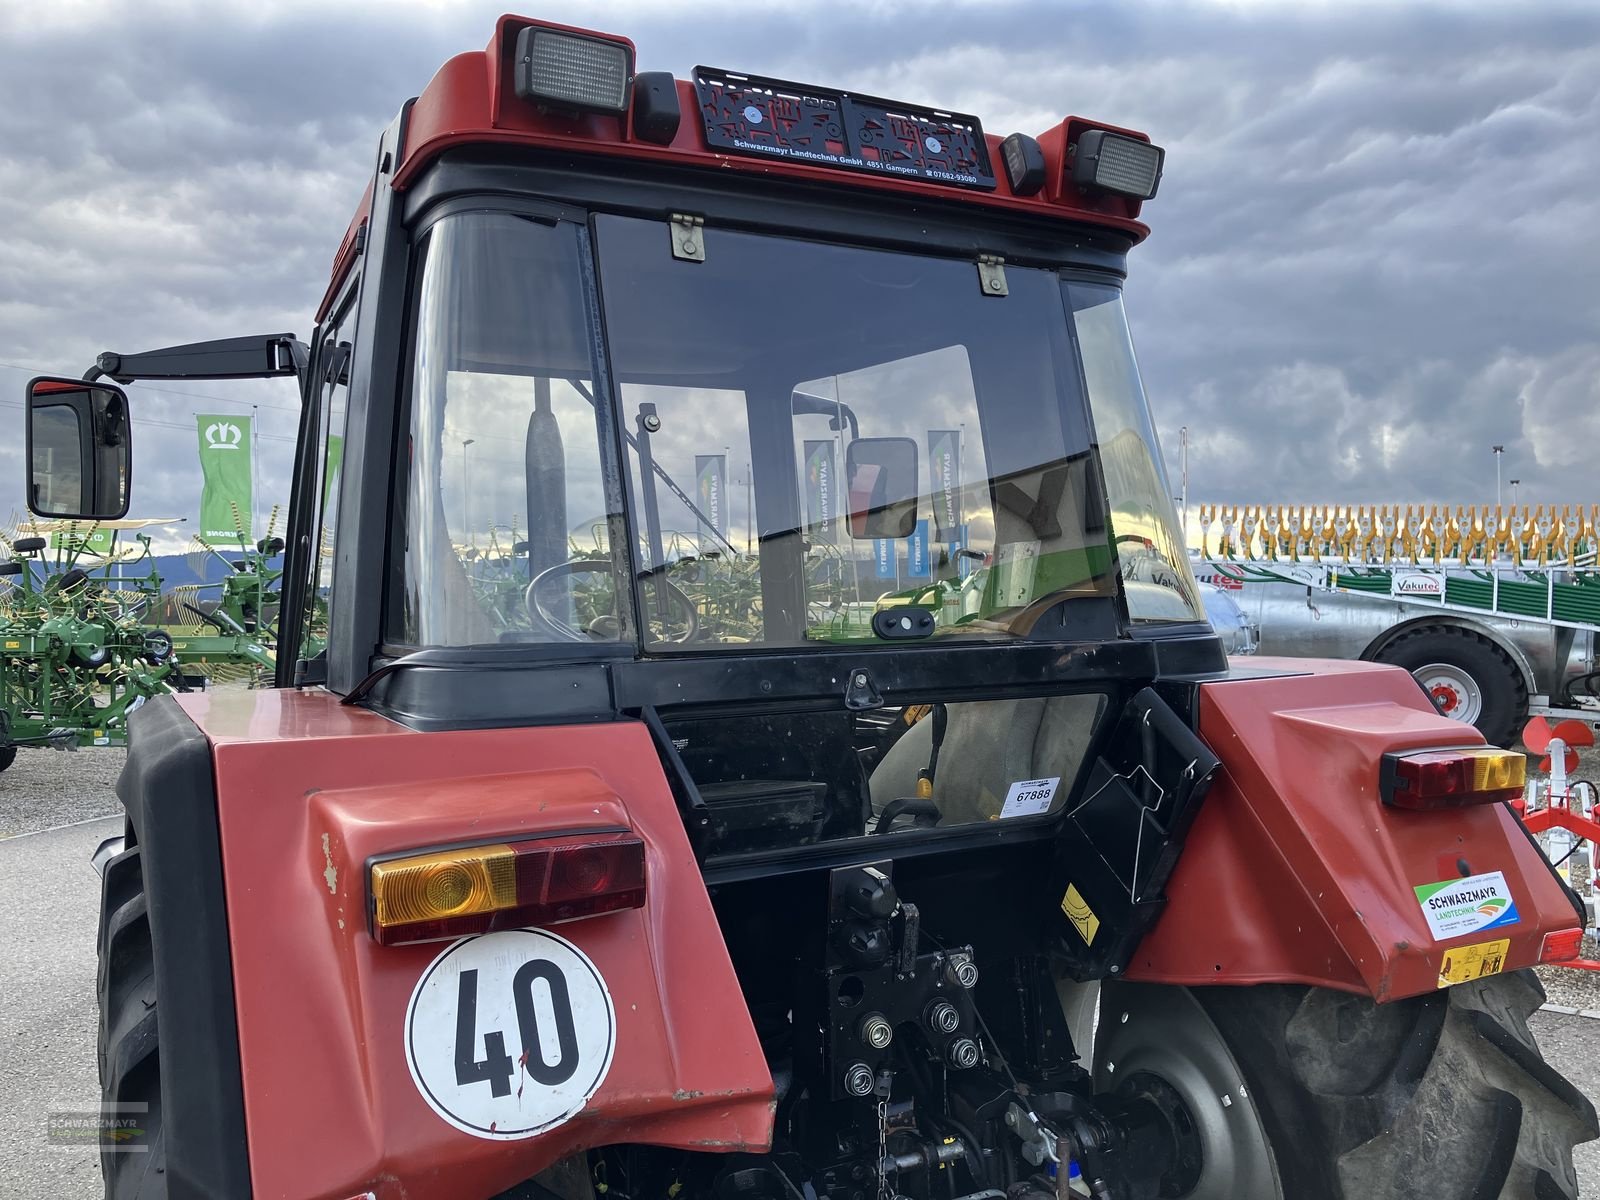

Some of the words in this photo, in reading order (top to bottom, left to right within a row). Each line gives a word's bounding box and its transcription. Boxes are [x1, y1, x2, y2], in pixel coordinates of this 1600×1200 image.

[734, 139, 788, 155] Schwarzmayr
[790, 148, 838, 162] Landtechnik
[840, 156, 862, 166] GmbH
[866, 161, 884, 169] 4851
[886, 163, 918, 175] Gampern
[1397, 580, 1440, 591] Vakutec
[1016, 789, 1051, 802] 67888
[1429, 886, 1497, 910] SCHWARZMAYR
[1435, 906, 1476, 921] LANDTECHNIK
[455, 959, 579, 1099] 40
